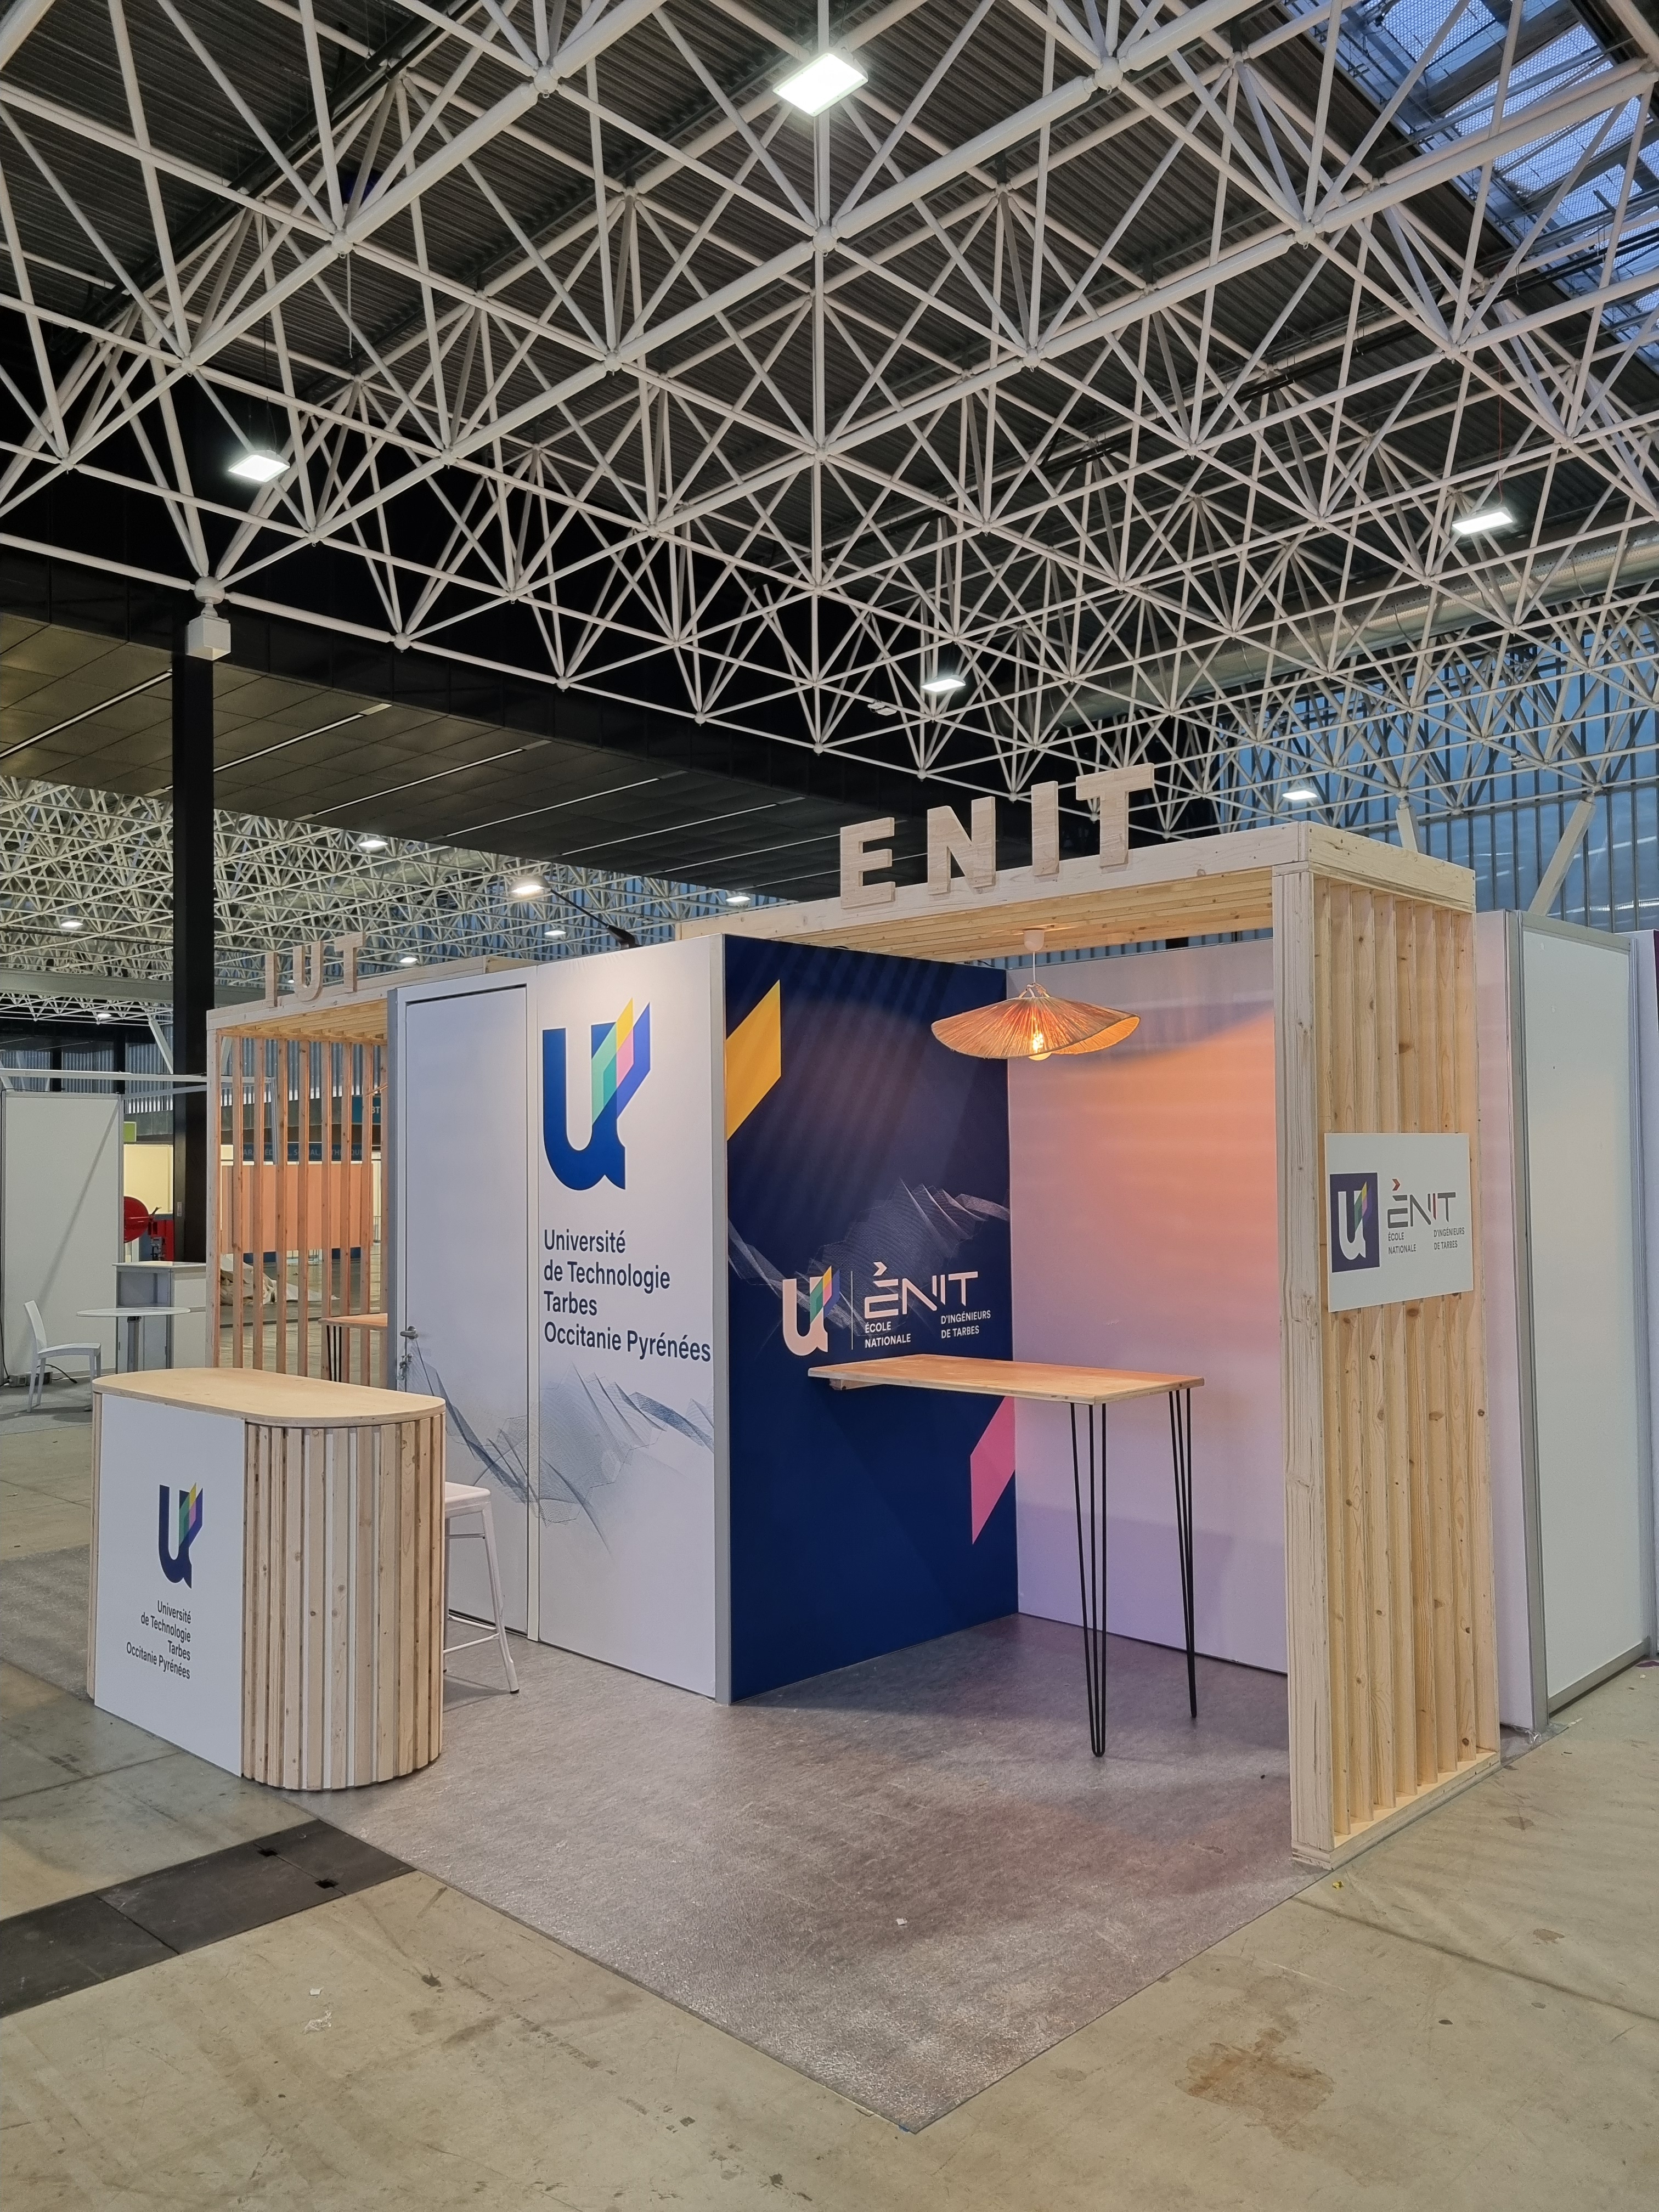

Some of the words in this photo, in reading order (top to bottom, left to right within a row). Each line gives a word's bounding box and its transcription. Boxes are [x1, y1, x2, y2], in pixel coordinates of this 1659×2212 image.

[840, 763, 1155, 909] ENIT
[265, 932, 366, 1007] IUT
[544, 1228, 626, 1254] Université
[1387, 1232, 1404, 1242] ÉCOLE
[1434, 1227, 1465, 1238] D'INGÉNIEURS
[1388, 1244, 1417, 1255] NATIONALE
[1434, 1242, 1440, 1250] DE
[1441, 1240, 1458, 1249] TARBES
[544, 1259, 563, 1282] de
[567, 1261, 670, 1294] Technologie
[543, 1290, 597, 1316] Tarbes
[865, 1321, 891, 1334] ÉCOLE
[941, 1310, 991, 1325] D'INGÉNIEURS
[544, 1321, 622, 1351] Occitanie
[627, 1330, 711, 1362] Pyrénées
[865, 1333, 911, 1348] NATIONALE
[941, 1329, 951, 1339] DE
[952, 1325, 980, 1337] TARBES
[157, 1600, 191, 1624] Université
[141, 1611, 149, 1626] de
[150, 1615, 191, 1643] Technologie
[126, 1641, 157, 1665] Occitanie
[159, 1655, 190, 1679] Pyrénées
[167, 1640, 191, 1661] Tarbes
